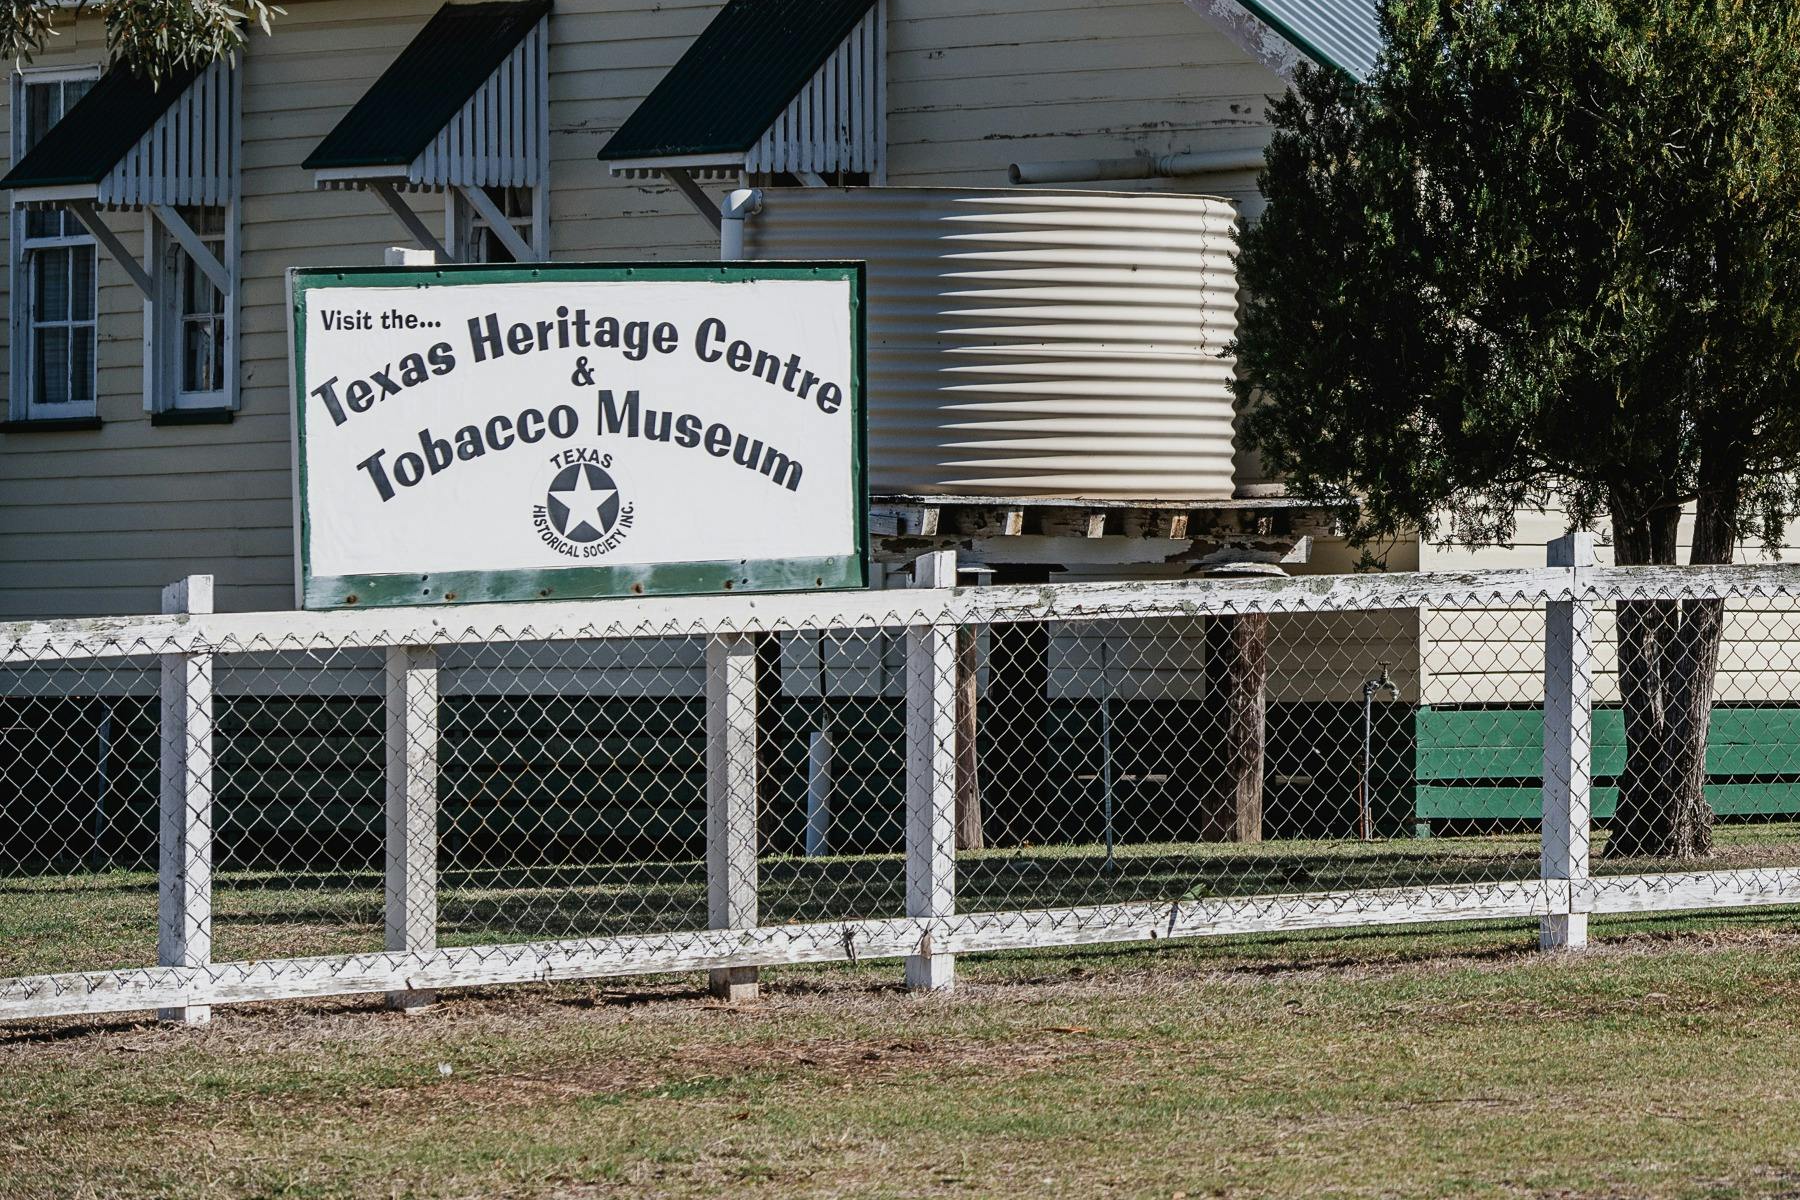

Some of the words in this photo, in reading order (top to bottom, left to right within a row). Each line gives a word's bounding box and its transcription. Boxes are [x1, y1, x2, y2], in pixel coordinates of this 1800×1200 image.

[320, 309, 373, 331] Visit
[380, 308, 442, 331] the...
[310, 341, 456, 427] Texas
[467, 305, 679, 363] Heritage
[694, 317, 843, 415] Centre
[571, 355, 596, 387] &
[356, 404, 579, 503] Tobacco
[597, 389, 803, 492] Museum
[549, 447, 613, 470] TEXAS
[532, 504, 580, 558] HISTORICAL
[583, 528, 627, 559] SOCIETY
[618, 501, 634, 529] INC.
